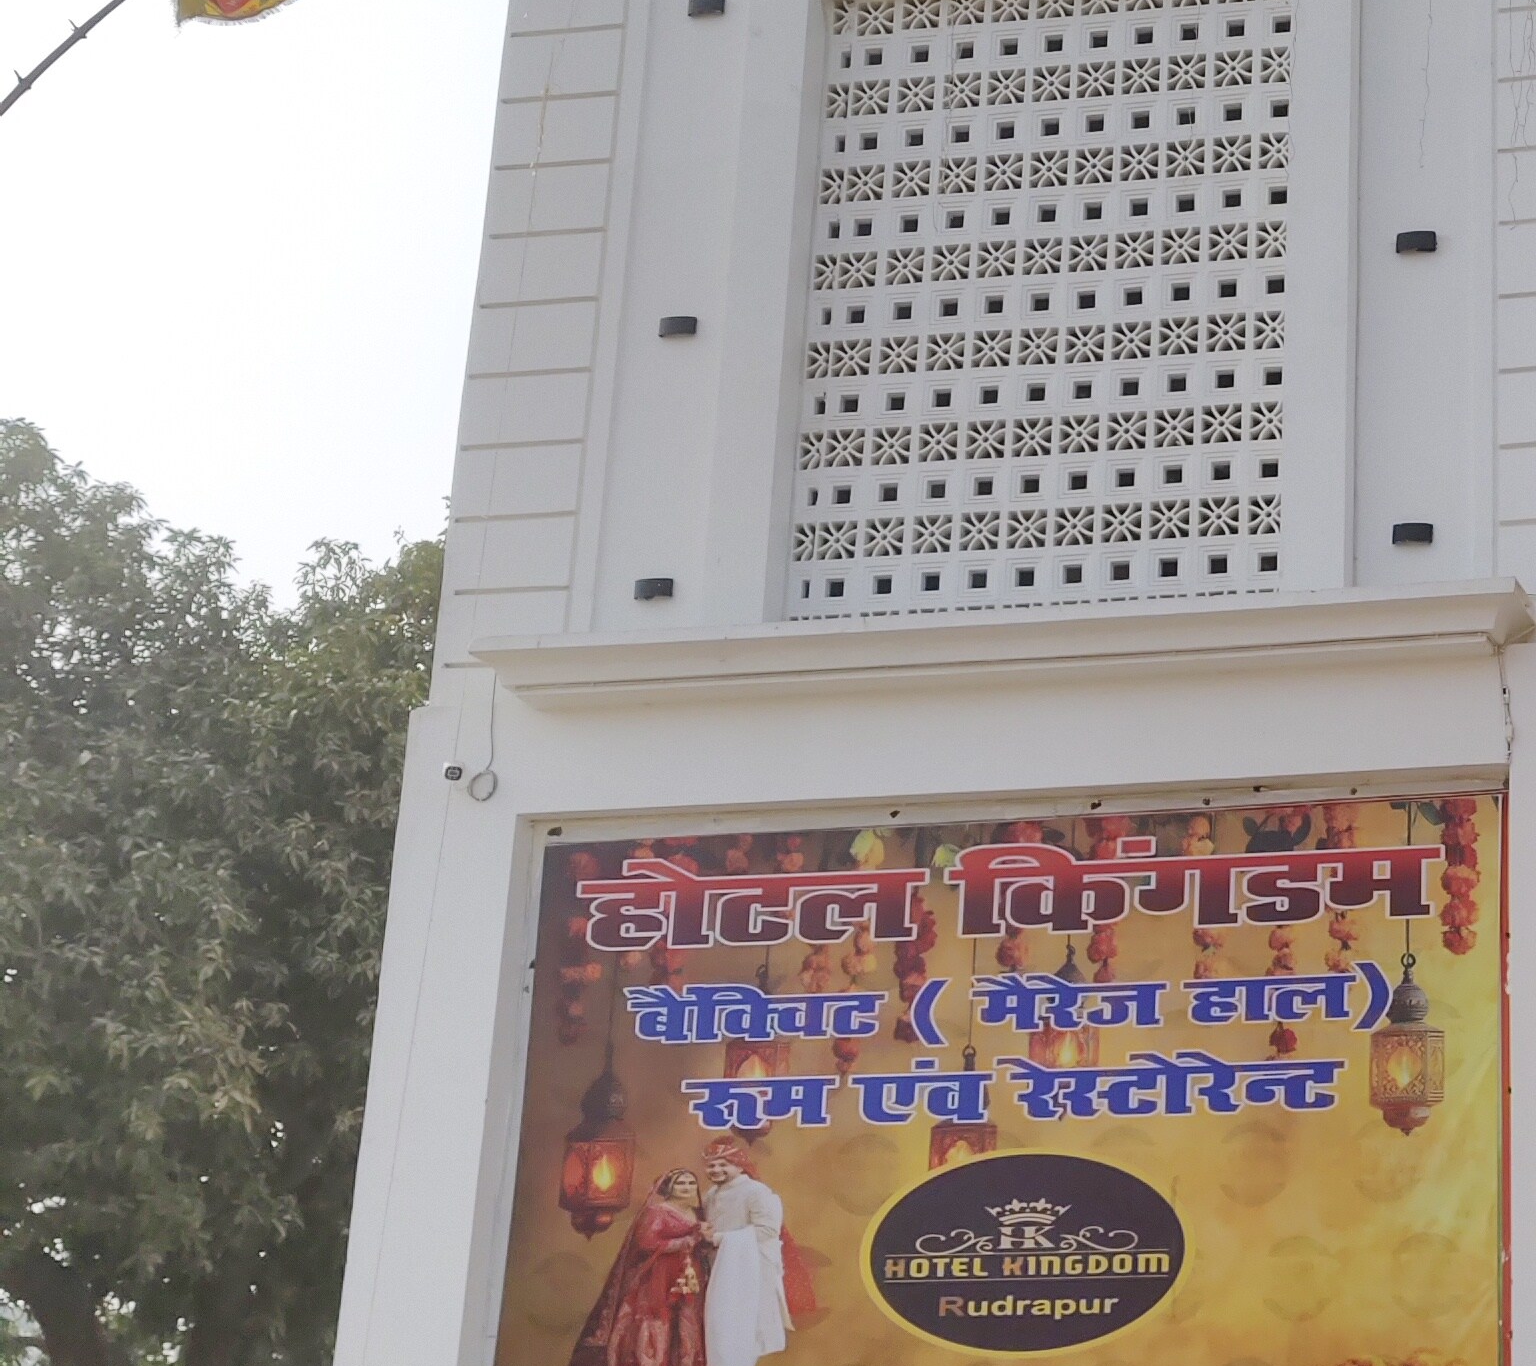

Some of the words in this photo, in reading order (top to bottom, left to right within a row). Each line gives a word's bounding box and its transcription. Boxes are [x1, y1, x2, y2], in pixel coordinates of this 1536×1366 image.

[577, 858, 929, 951] होटल
[945, 836, 1445, 937] किंगडम
[681, 1076, 839, 1129] रूम
[995, 1051, 1349, 1121] रेस्टोरेन्ट
[885, 1256, 989, 1279] HOTEL
[1002, 1253, 1170, 1277] KINGDOM
[938, 1295, 1119, 1320] Rudrapur
